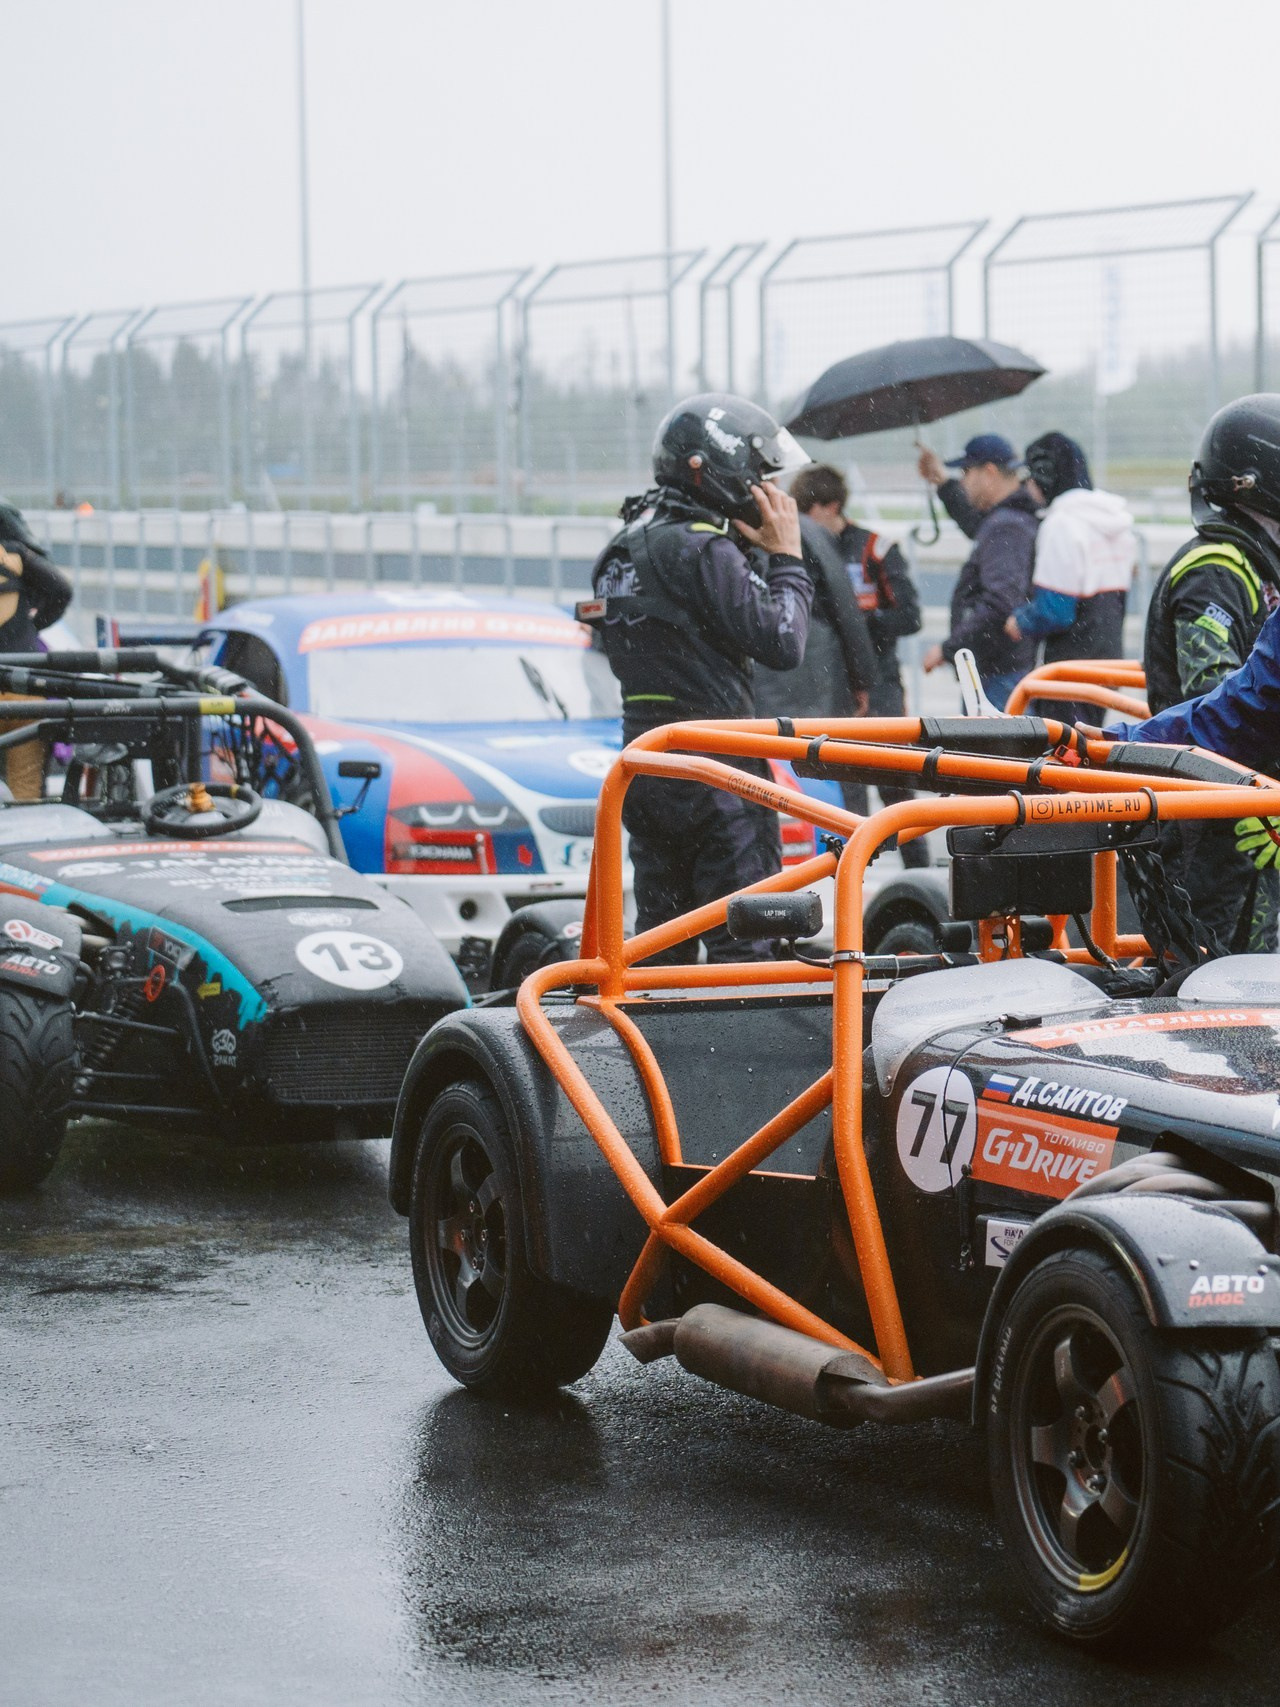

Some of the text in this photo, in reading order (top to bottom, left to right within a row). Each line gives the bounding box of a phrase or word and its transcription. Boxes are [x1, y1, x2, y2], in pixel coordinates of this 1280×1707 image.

[1205, 605, 1232, 628] OMP
[1057, 799, 1141, 814] LAPTIME_RU
[775, 909, 787, 917] TIME
[6, 953, 61, 975] АВТО
[313, 938, 386, 973] 13
[1040, 1013, 1248, 1041] ЗАПРАВЛЕНО
[909, 1089, 970, 1165] 77
[1044, 1131, 1105, 1153] ТОПЛИВО
[1190, 1275, 1265, 1294] АВТО
[1187, 1293, 1246, 1308] ПЛЮС
